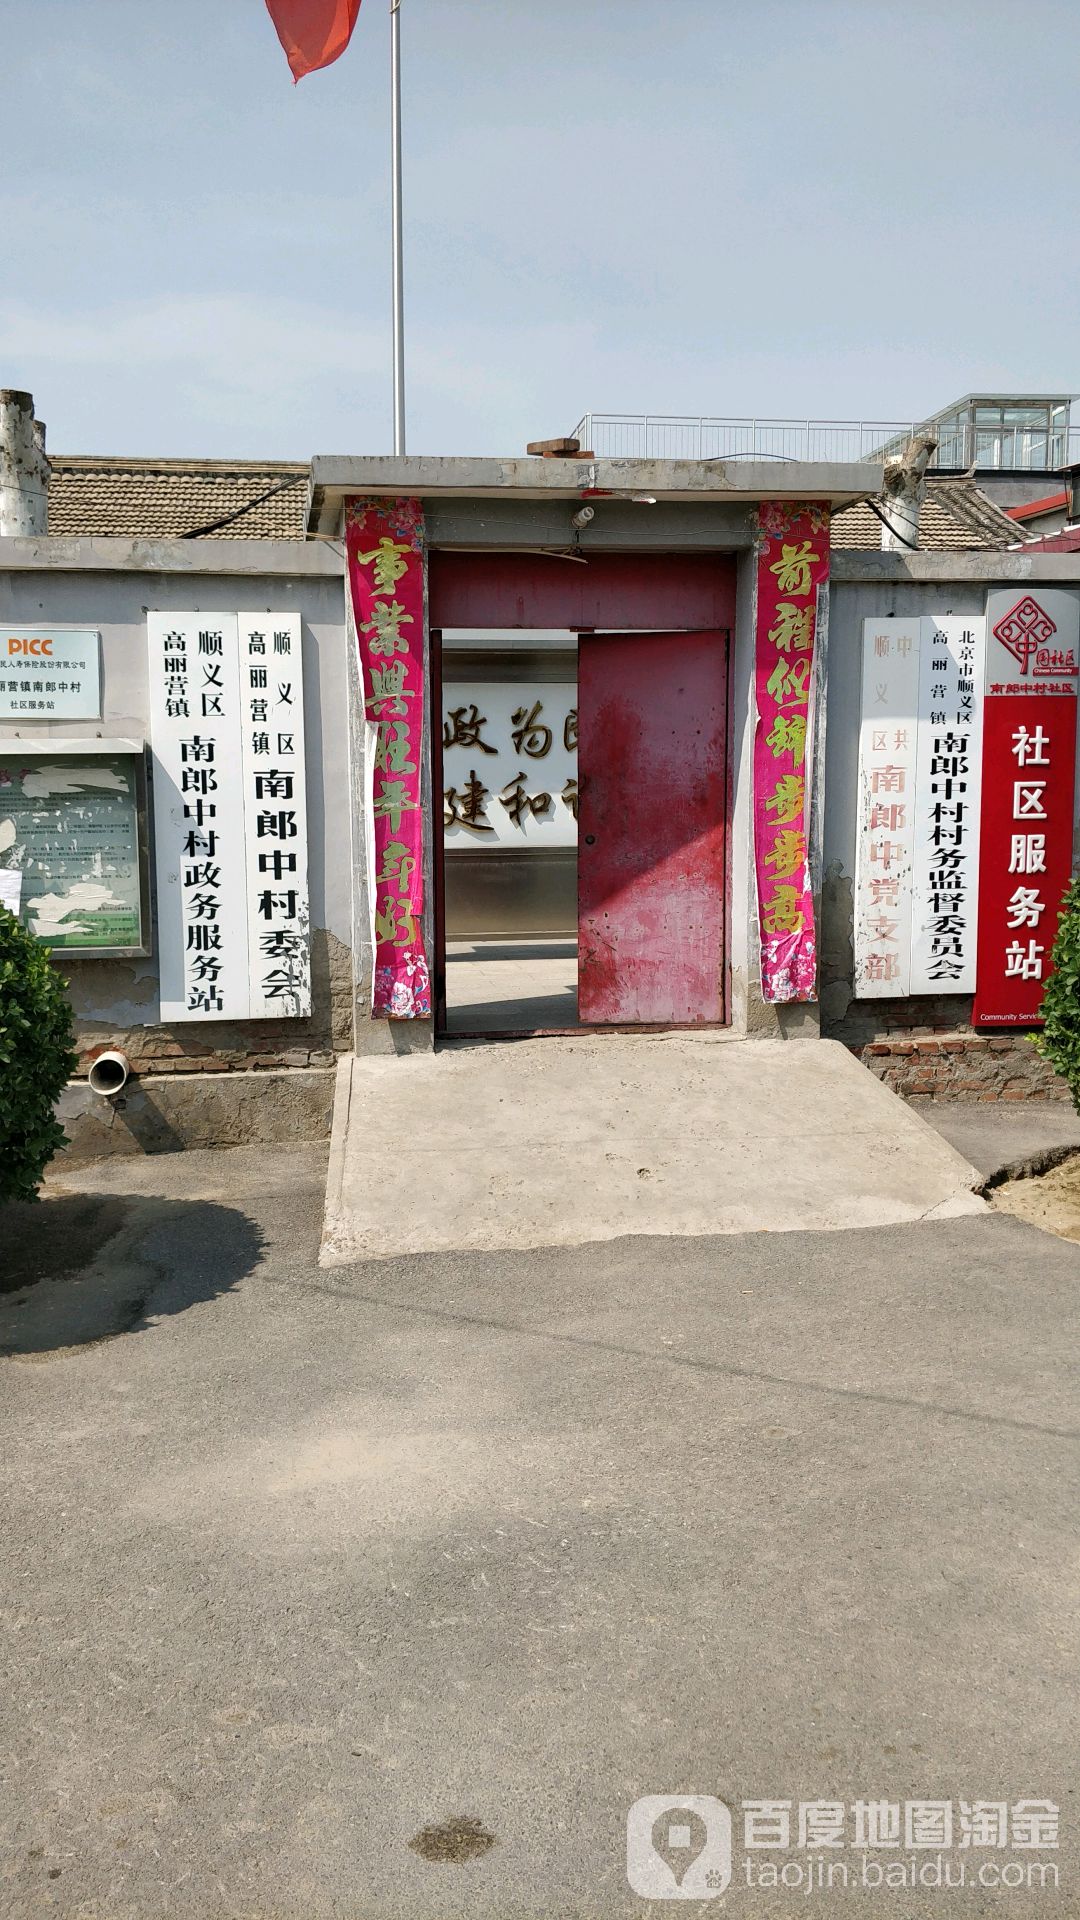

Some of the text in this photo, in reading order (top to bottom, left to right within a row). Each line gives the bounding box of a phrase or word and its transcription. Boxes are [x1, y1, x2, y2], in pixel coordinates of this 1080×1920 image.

[8, 638, 53, 655] PICC
[162, 630, 190, 717] 高丽营镇
[198, 630, 226, 717] 顺义区
[247, 631, 271, 755] 高丽营镇
[273, 630, 296, 755] 顺义区
[930, 630, 950, 725] 高丽营镇
[956, 630, 975, 724] 北京市顺义区
[990, 682, 1074, 695] 南郎中村社区
[10, 700, 55, 709] 社区服务站
[178, 735, 225, 1012] 南郎中村政务服务站
[253, 769, 301, 1000] 南郎中村委会
[865, 764, 908, 982] 南郎中党支部
[924, 732, 971, 981] 南郎中村村务监督委员会
[1004, 725, 1050, 981] 社区服务站
[980, 1013, 1017, 1021] Community
